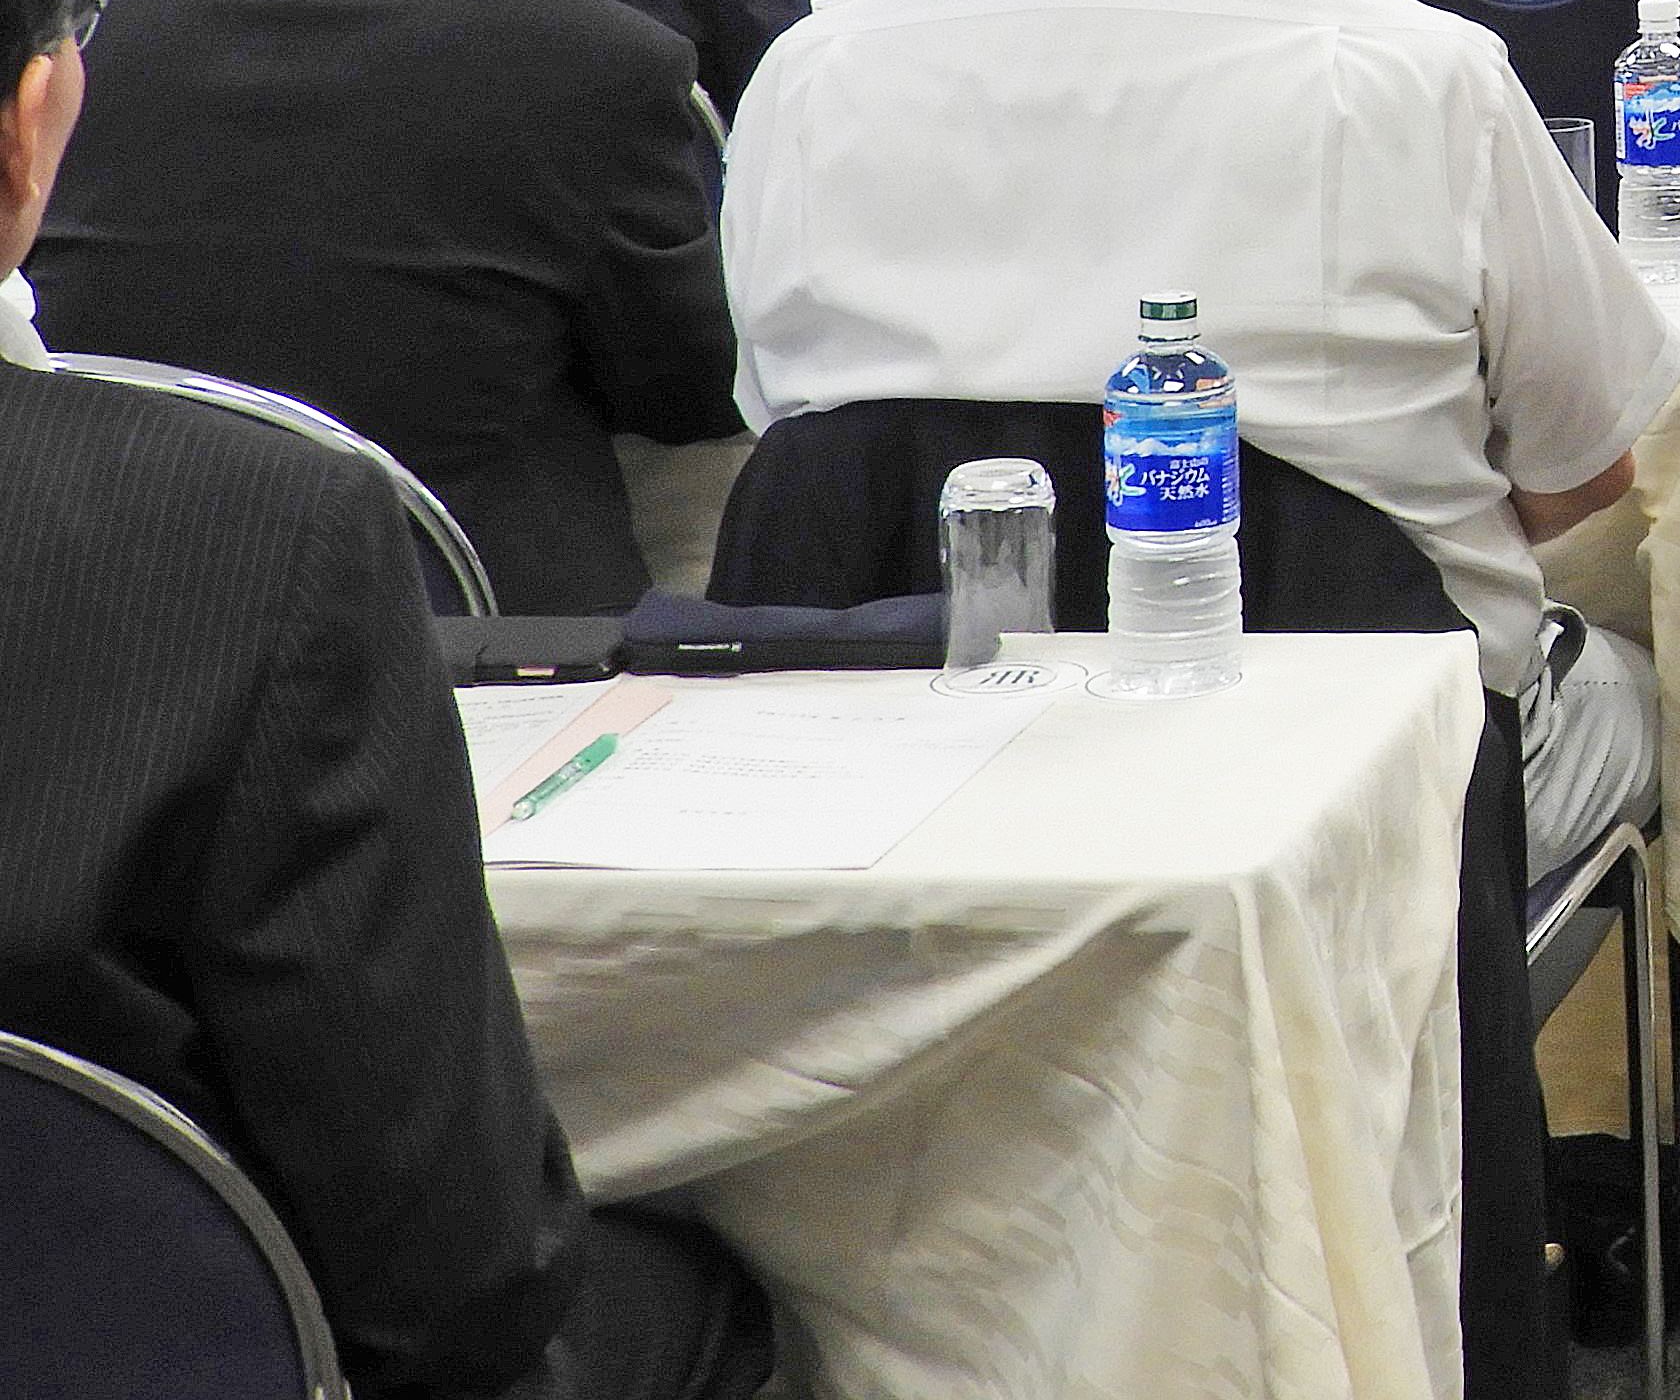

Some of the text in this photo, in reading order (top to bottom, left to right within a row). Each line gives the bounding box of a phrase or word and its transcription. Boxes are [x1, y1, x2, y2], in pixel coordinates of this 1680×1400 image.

[1140, 468, 1211, 486] バナジウム
[1159, 483, 1210, 501] 天然水
